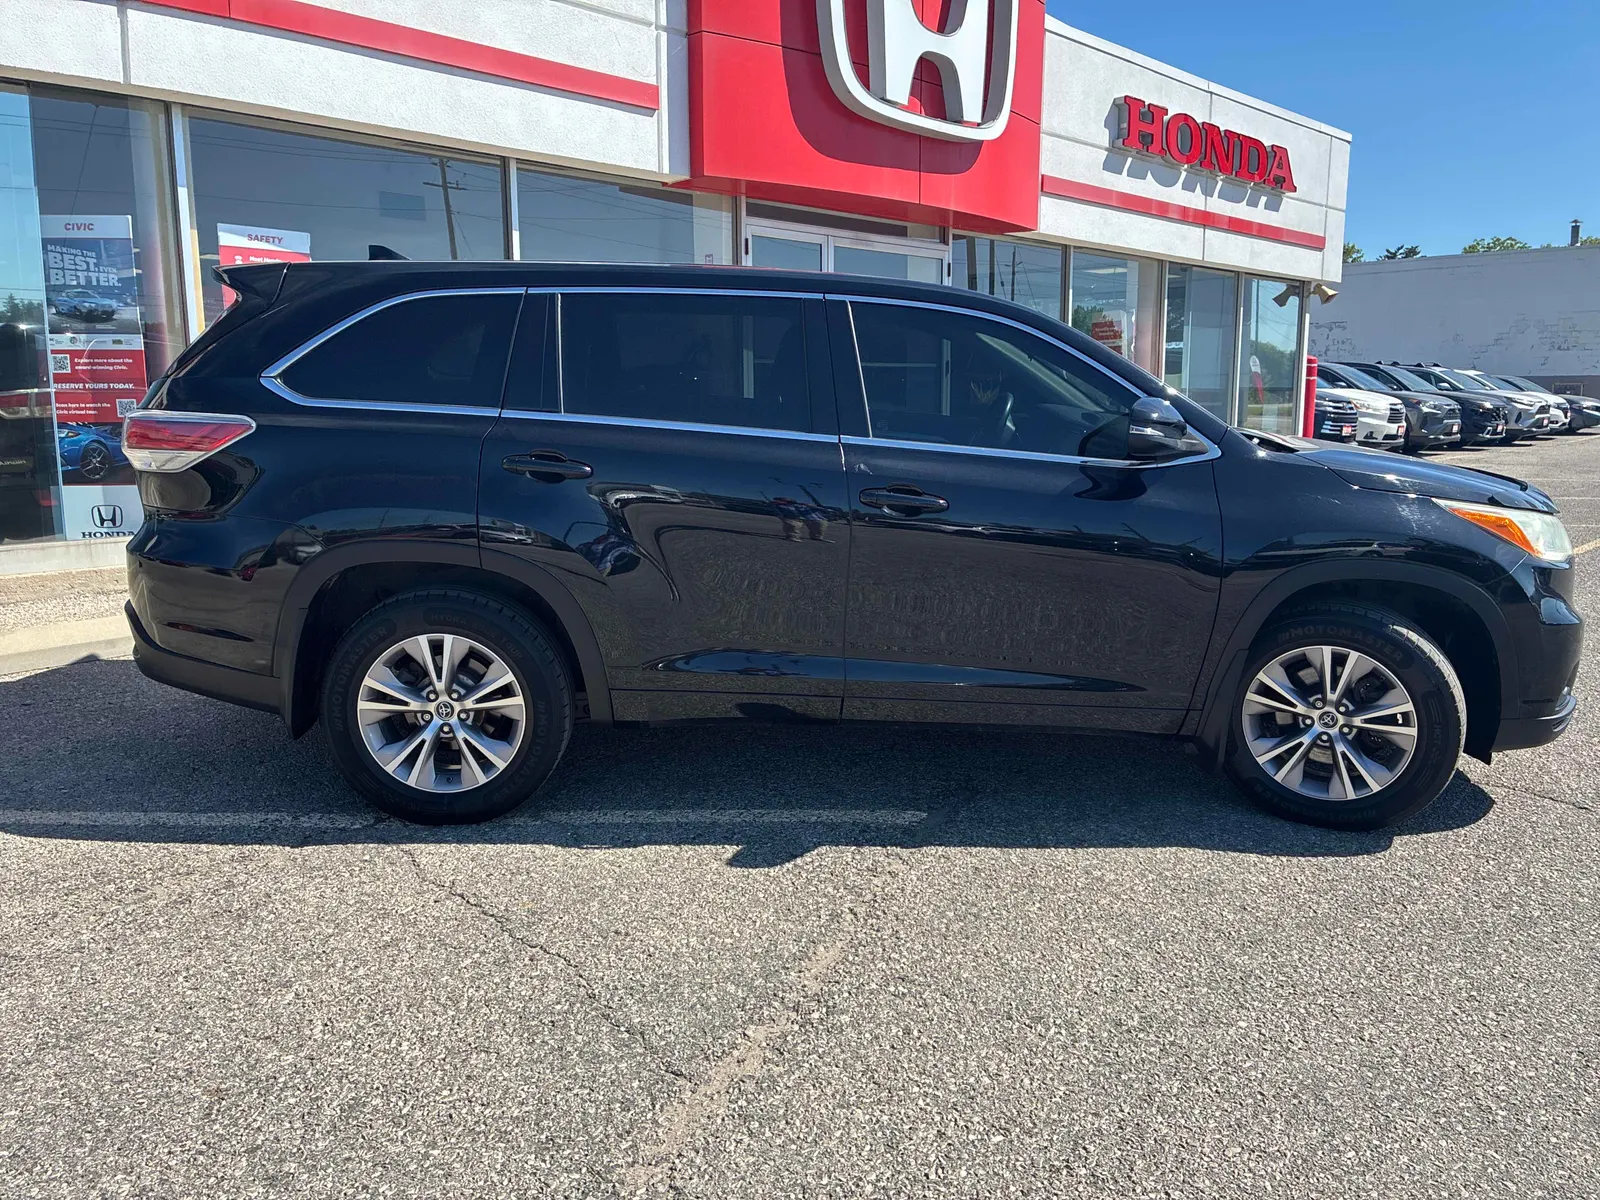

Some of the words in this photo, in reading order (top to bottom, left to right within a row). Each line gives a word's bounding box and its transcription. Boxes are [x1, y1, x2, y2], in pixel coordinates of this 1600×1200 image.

[1120, 95, 1297, 193] HONDA
[64, 222, 95, 231] CIVIC
[247, 233, 283, 244] SAFETY
[47, 244, 81, 256] MAKING
[82, 250, 97, 258] THE
[47, 251, 98, 272] BEST,
[49, 268, 122, 287] BETTER.
[81, 531, 136, 539] HONDA
